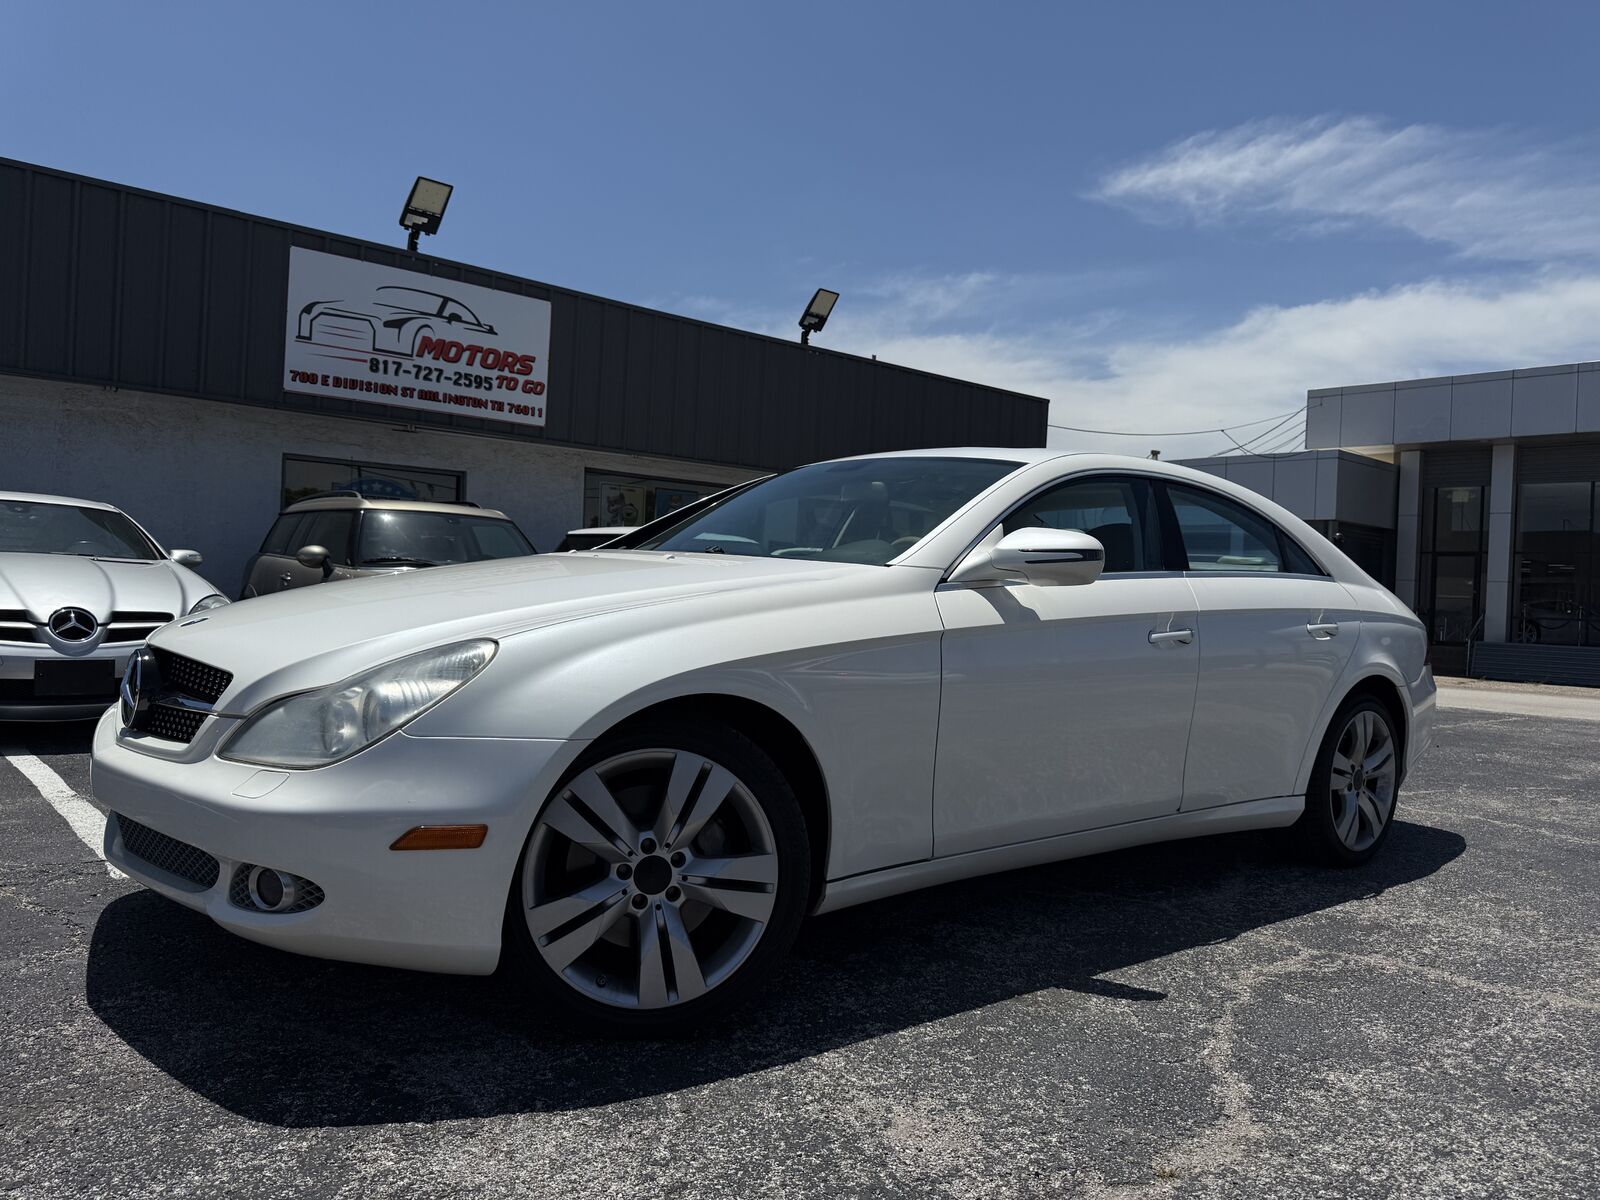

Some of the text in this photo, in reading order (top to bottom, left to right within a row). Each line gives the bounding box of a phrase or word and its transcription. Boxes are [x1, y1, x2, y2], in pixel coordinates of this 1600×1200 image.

[368, 357, 494, 392] 817-727-2595
[415, 335, 536, 376] MOTORS
[289, 369, 543, 418] 700 E DIVISION ST ARLINGTON TX 76011
[495, 375, 546, 396] TO GO
